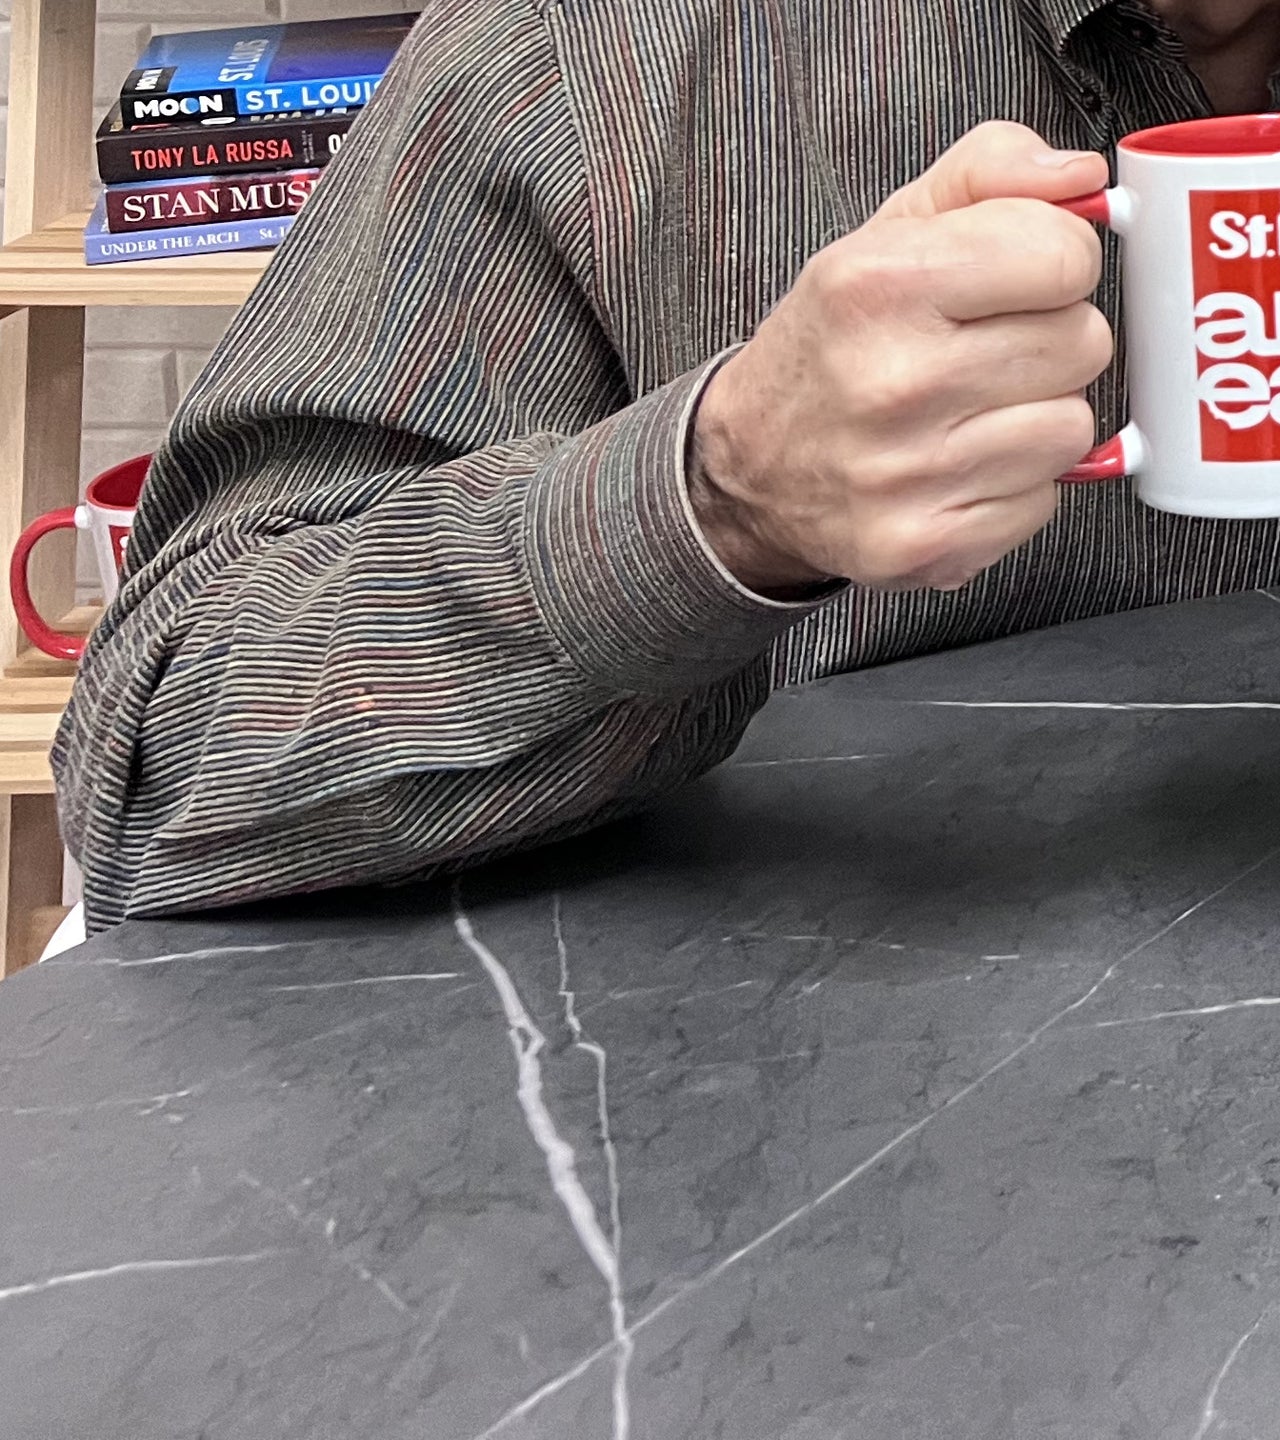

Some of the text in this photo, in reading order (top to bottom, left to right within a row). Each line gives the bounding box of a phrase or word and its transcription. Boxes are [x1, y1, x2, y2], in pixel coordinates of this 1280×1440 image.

[134, 94, 223, 118] MOON
[246, 89, 292, 110] ST.
[131, 147, 184, 171] TONY
[193, 143, 219, 165] LA
[226, 139, 293, 163] RUSSA
[123, 179, 316, 222] STAN MUS
[101, 231, 239, 256] UNDER THE ARCH
